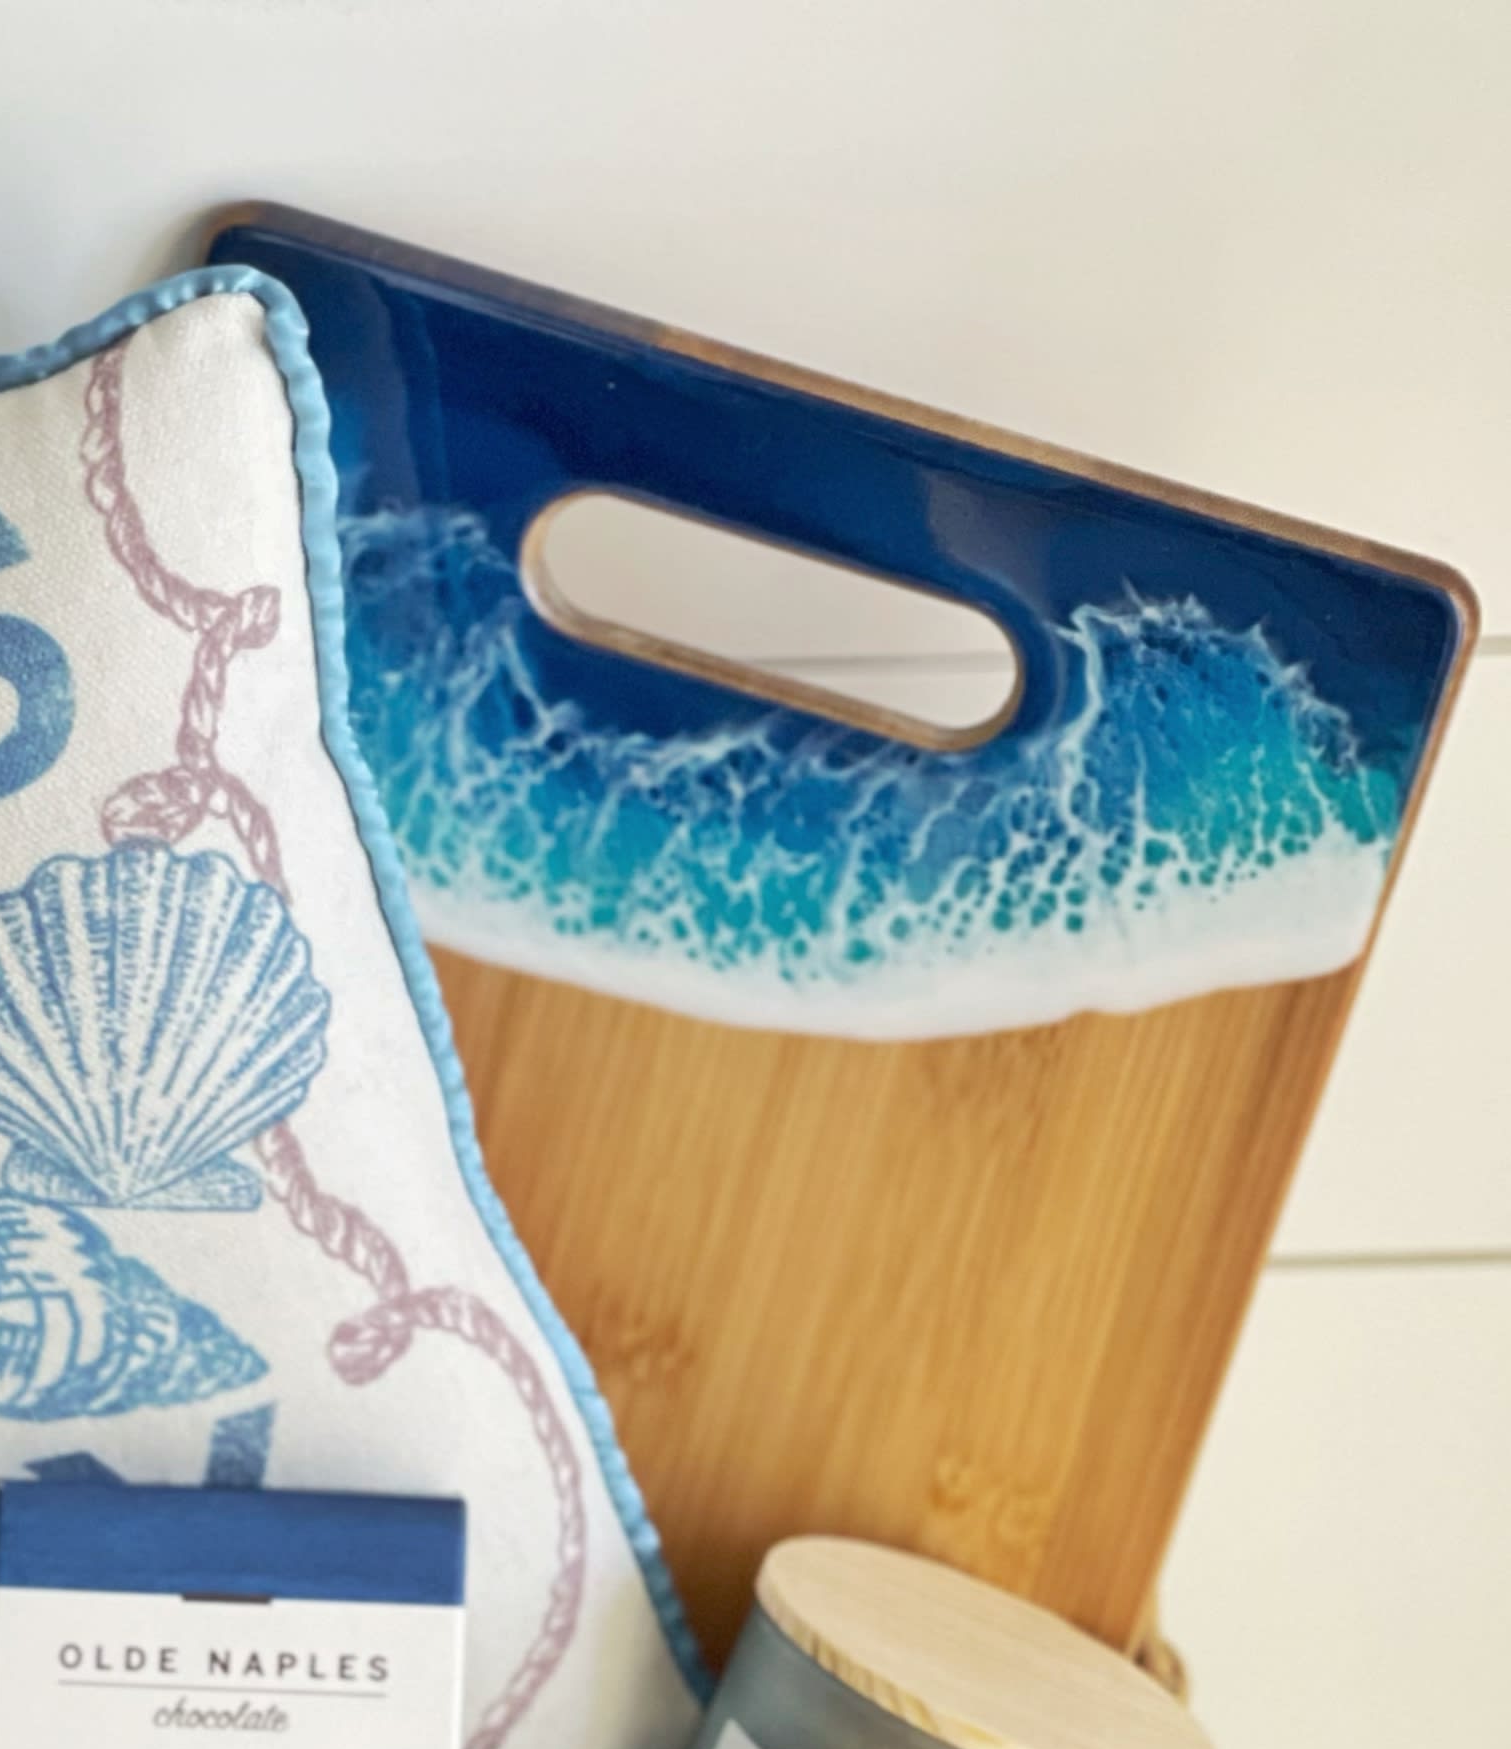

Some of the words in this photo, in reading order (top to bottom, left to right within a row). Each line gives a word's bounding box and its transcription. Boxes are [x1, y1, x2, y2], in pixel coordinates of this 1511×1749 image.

[58, 1644, 179, 1674] OLDE
[207, 1649, 389, 1682] NAPLES
[152, 1695, 288, 1734] chocolate
